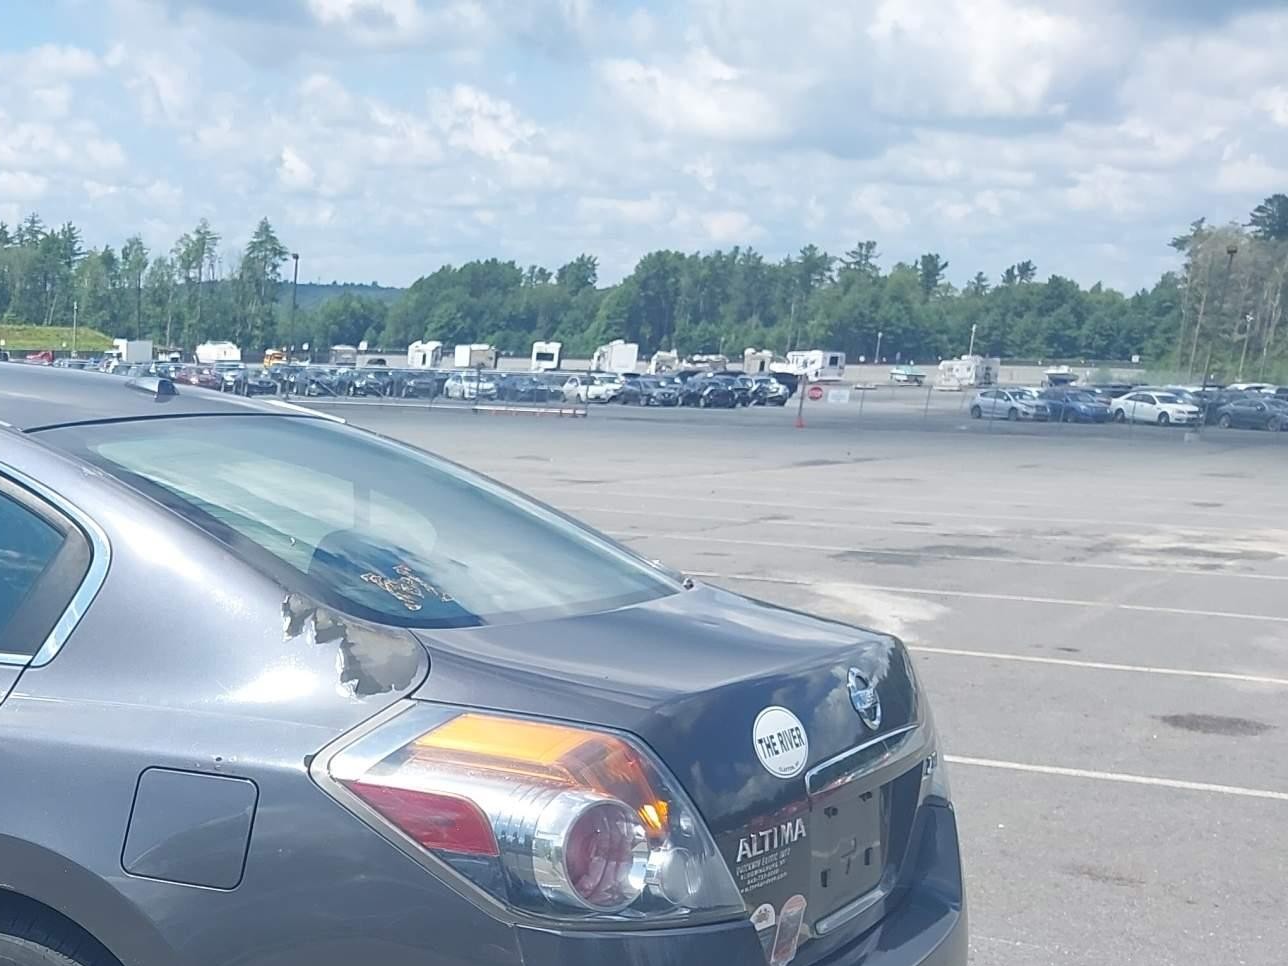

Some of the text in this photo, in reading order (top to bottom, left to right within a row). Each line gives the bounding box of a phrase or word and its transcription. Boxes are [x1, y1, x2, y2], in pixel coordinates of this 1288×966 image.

[757, 726, 805, 760] THE RIVER
[736, 817, 807, 863] ALTIMA
